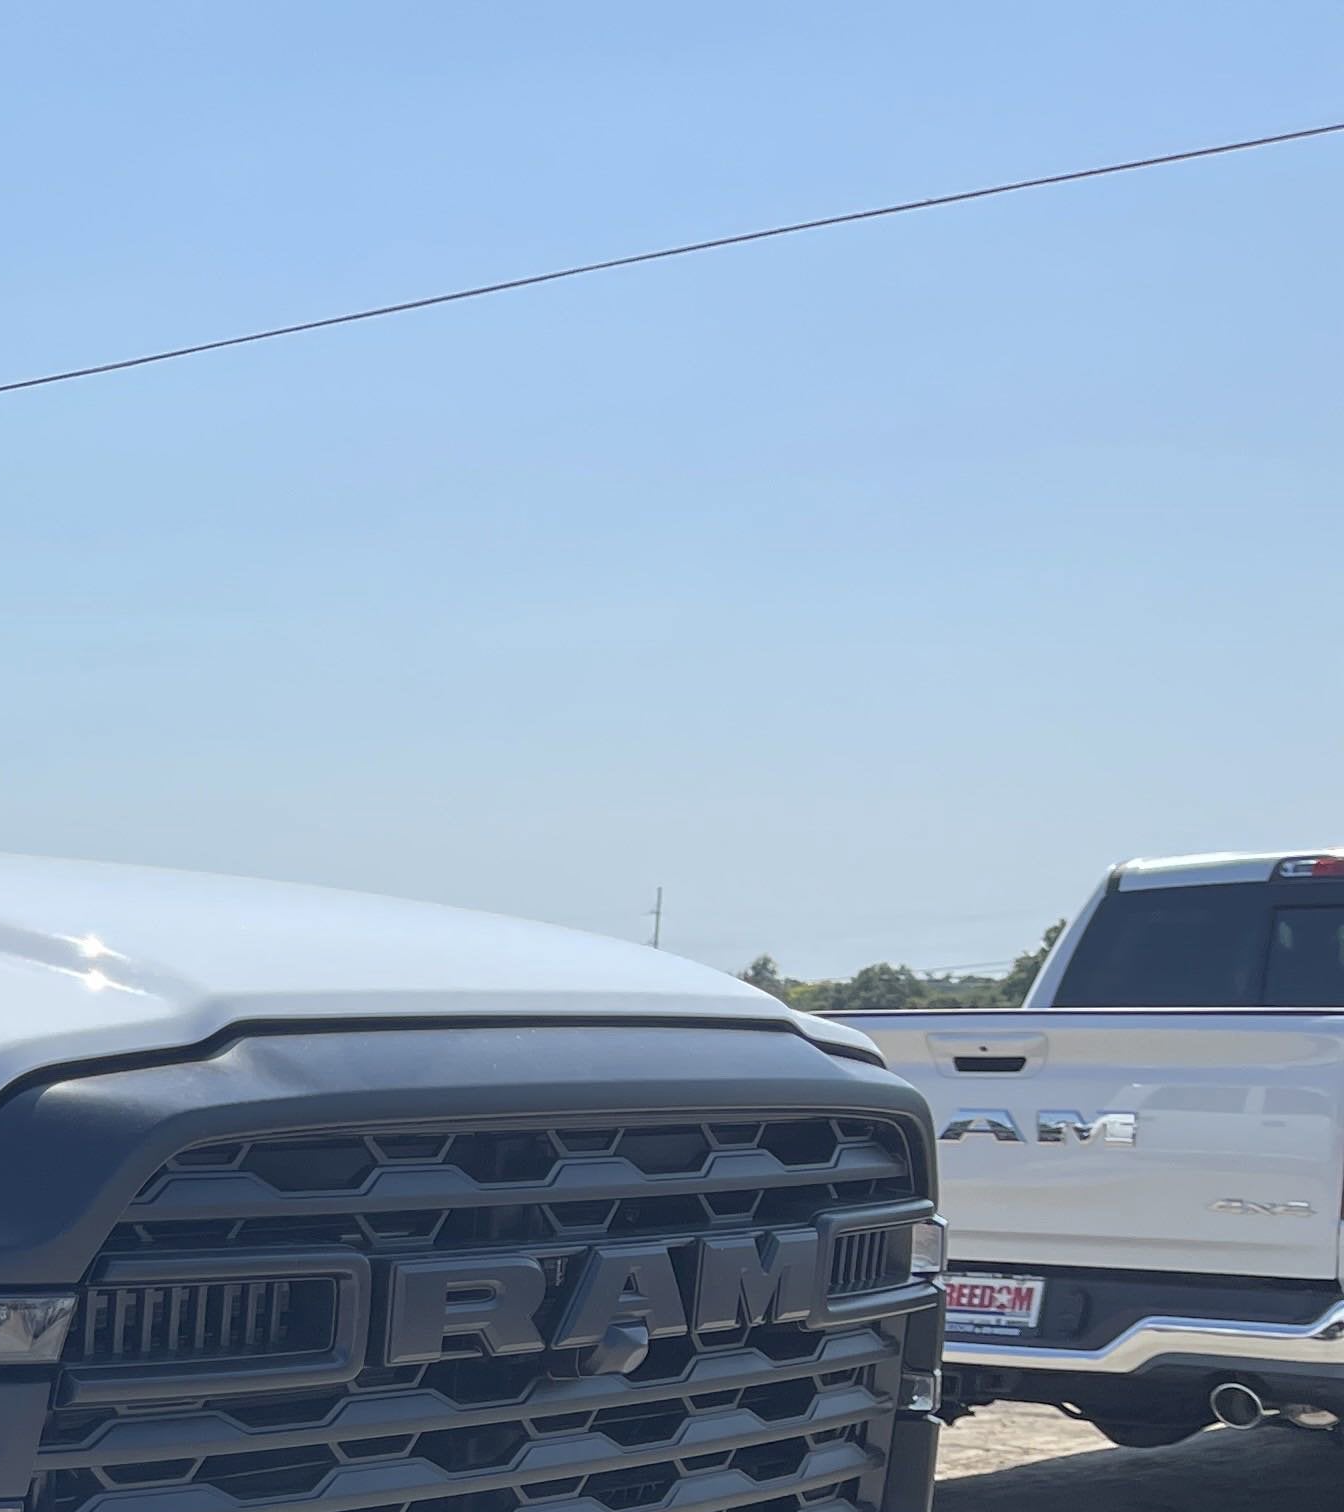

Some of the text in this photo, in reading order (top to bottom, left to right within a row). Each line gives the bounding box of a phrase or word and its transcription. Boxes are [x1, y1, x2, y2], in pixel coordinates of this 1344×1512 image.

[938, 1107, 1141, 1147] AM
[385, 1226, 819, 1367] RAM
[945, 1283, 1035, 1312] REEDOM
